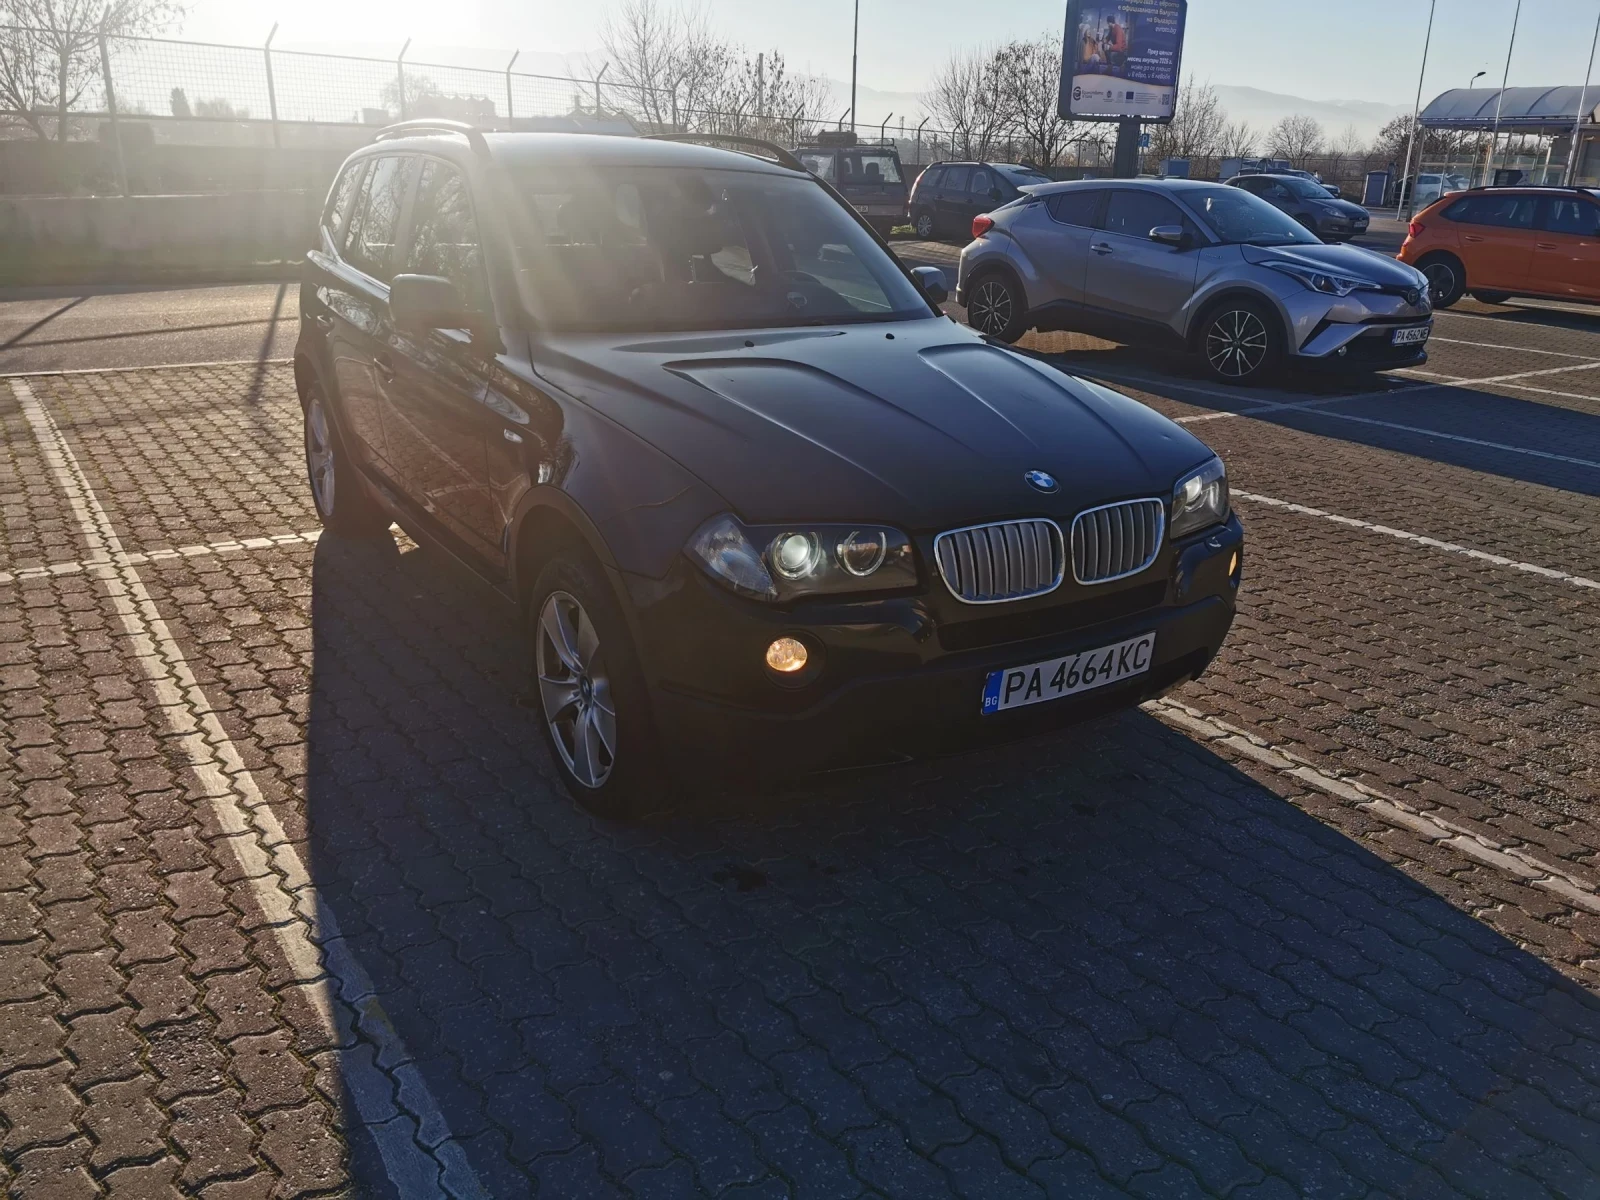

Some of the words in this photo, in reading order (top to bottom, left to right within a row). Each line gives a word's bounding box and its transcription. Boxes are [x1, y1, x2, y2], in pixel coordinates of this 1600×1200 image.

[1122, 5, 1158, 14] официалната
[1159, 8, 1178, 17] валута
[1004, 667, 1042, 704] PA
[985, 696, 997, 707] BG
